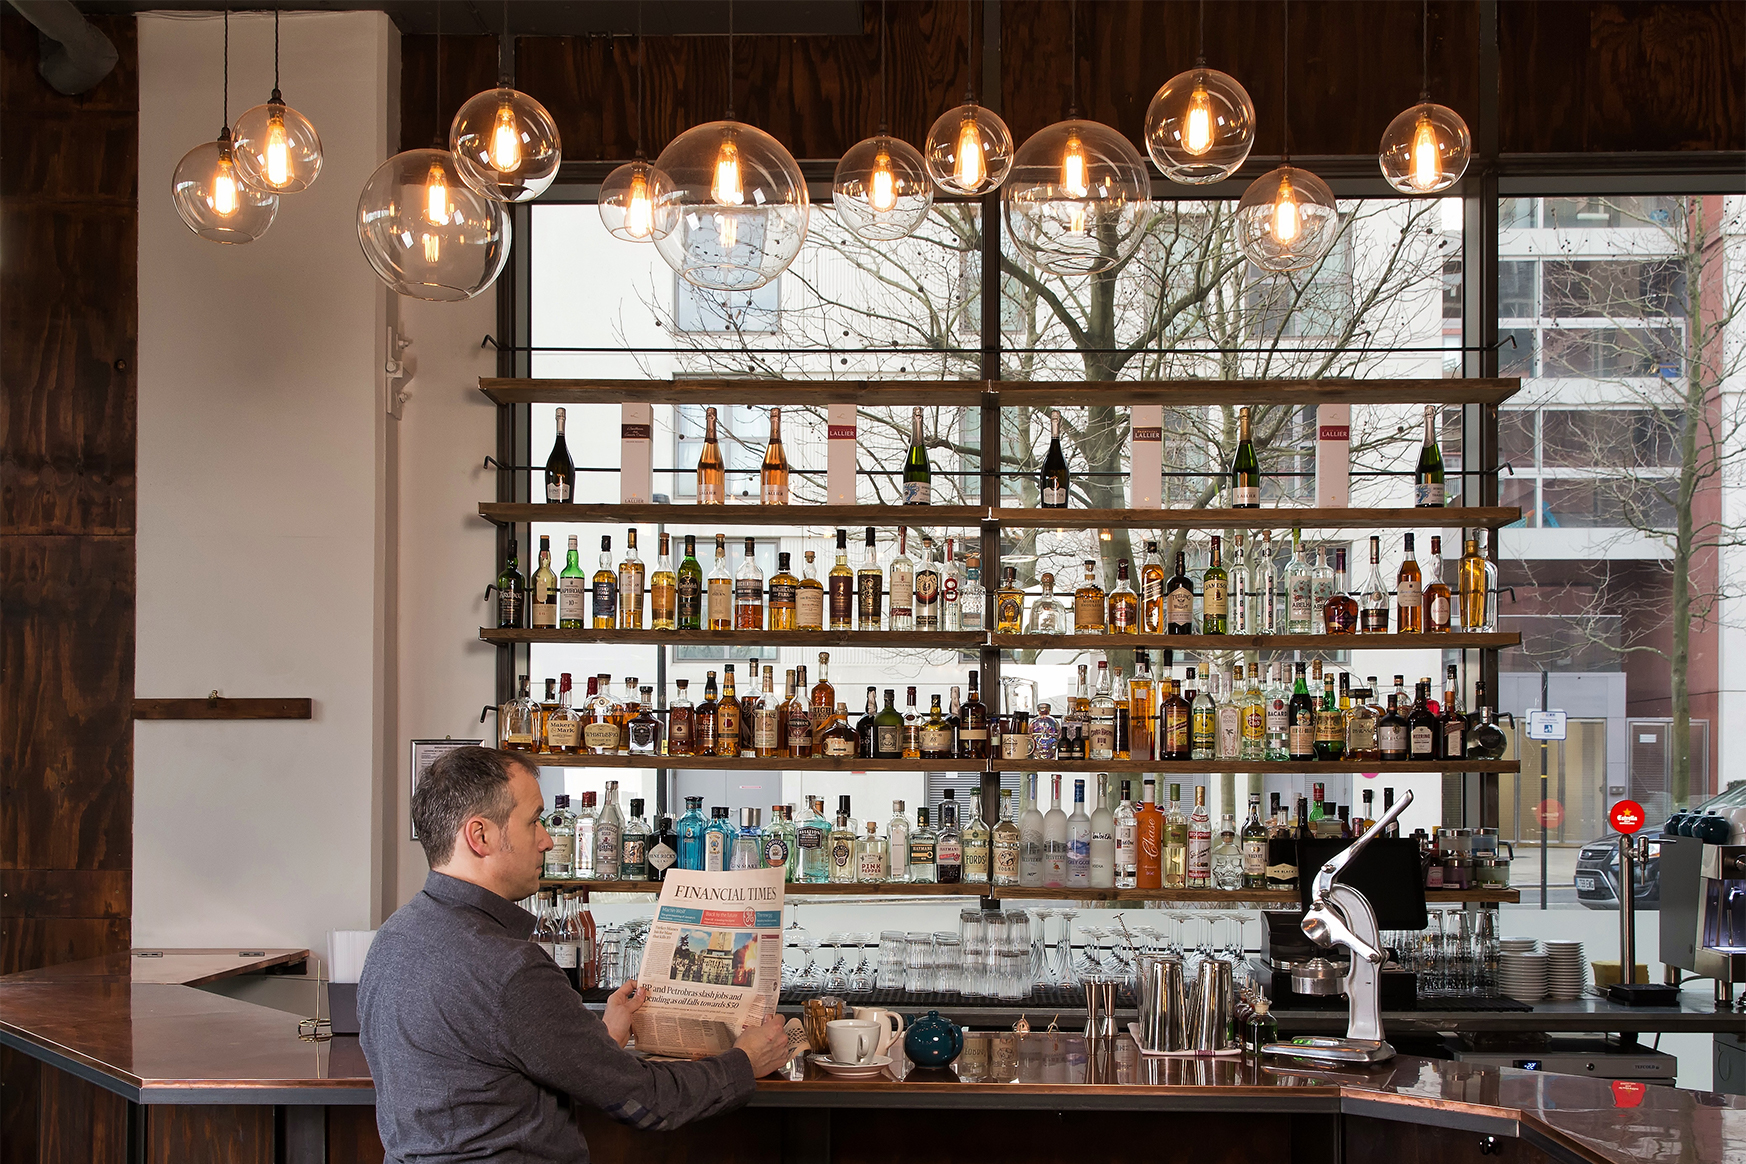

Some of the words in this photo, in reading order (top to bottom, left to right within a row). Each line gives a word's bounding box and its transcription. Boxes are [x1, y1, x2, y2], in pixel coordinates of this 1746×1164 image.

[1142, 817, 1159, 860] Chase
[965, 854, 986, 865] FORDS
[674, 885, 746, 901] FINANCIAL
[747, 887, 777, 901] TIMES
[642, 983, 653, 992] BP
[653, 985, 667, 994] and
[667, 986, 698, 997] Petrobras
[698, 989, 715, 999] slash
[713, 990, 729, 1001] jobs
[729, 992, 743, 1001] and
[643, 995, 670, 1005] pending
[678, 997, 688, 1005] oil
[687, 998, 700, 1006] falls
[700, 1000, 727, 1008] towards
